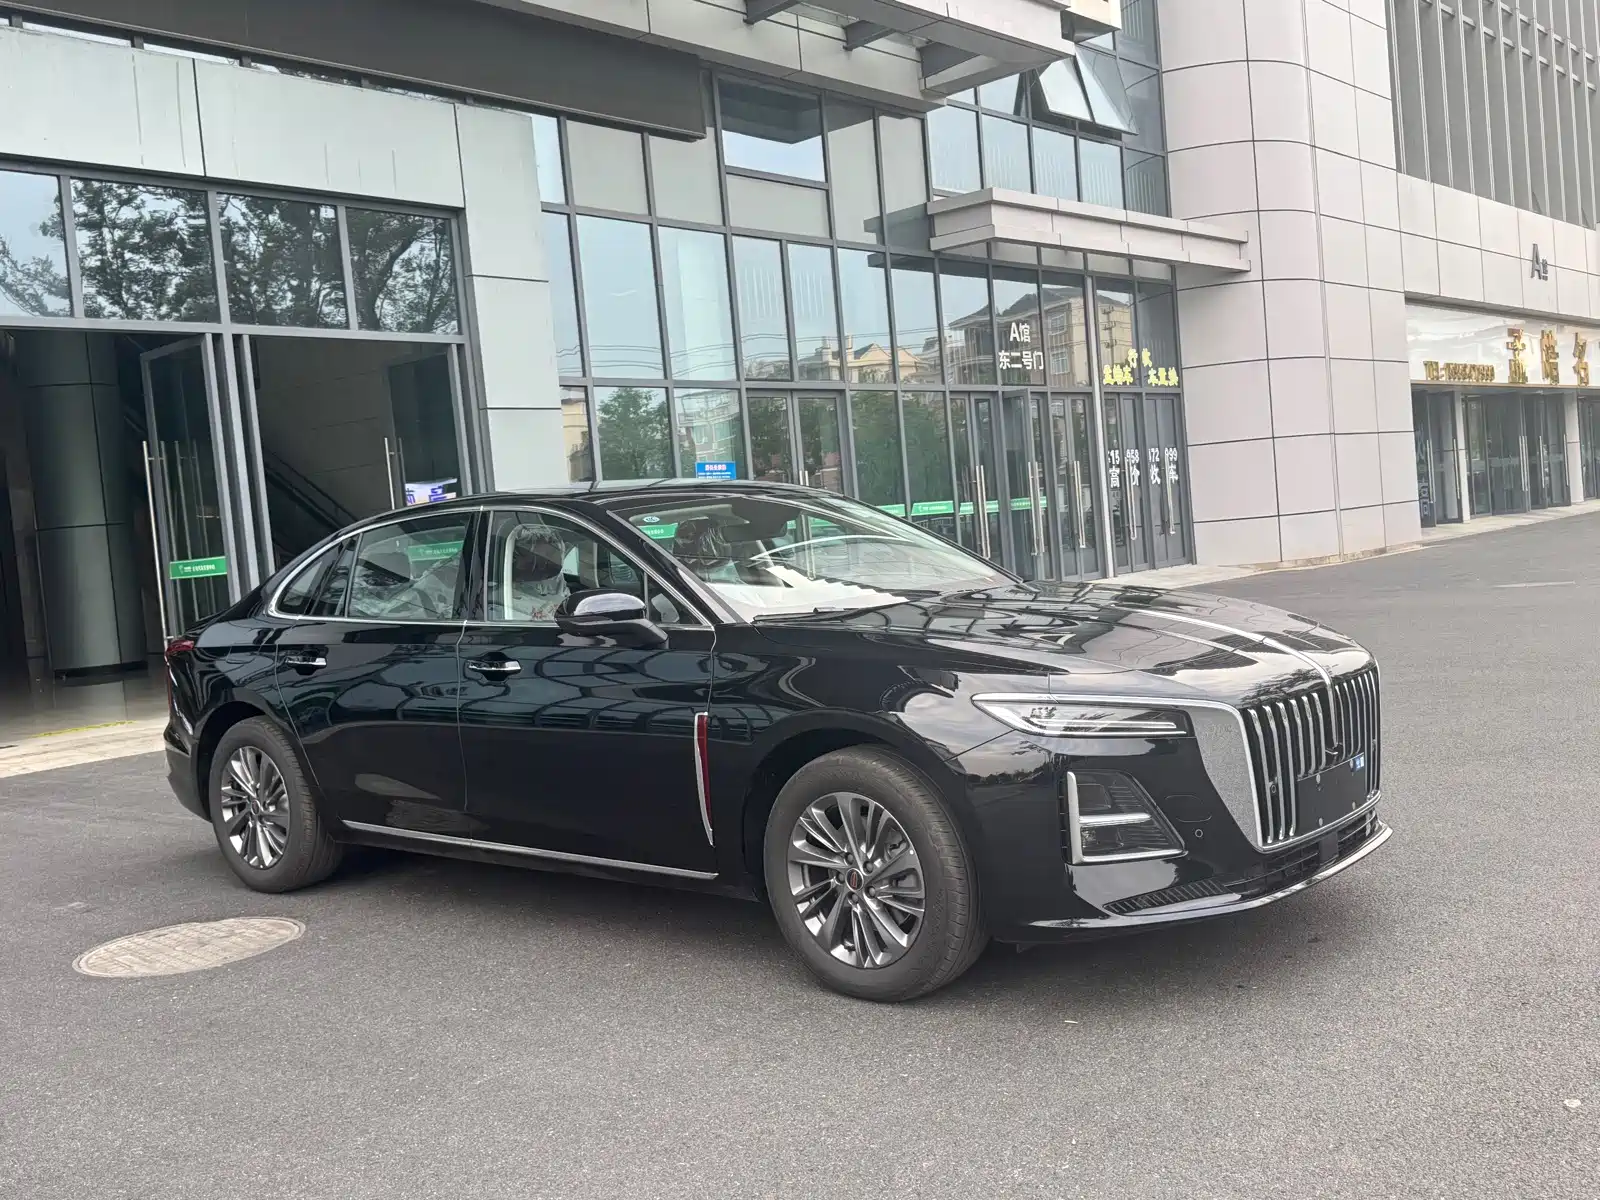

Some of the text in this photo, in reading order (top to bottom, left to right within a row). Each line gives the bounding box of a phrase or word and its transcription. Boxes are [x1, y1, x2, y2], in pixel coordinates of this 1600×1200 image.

[1009, 322, 1031, 343] A馆
[998, 349, 1044, 370] 东二号门
